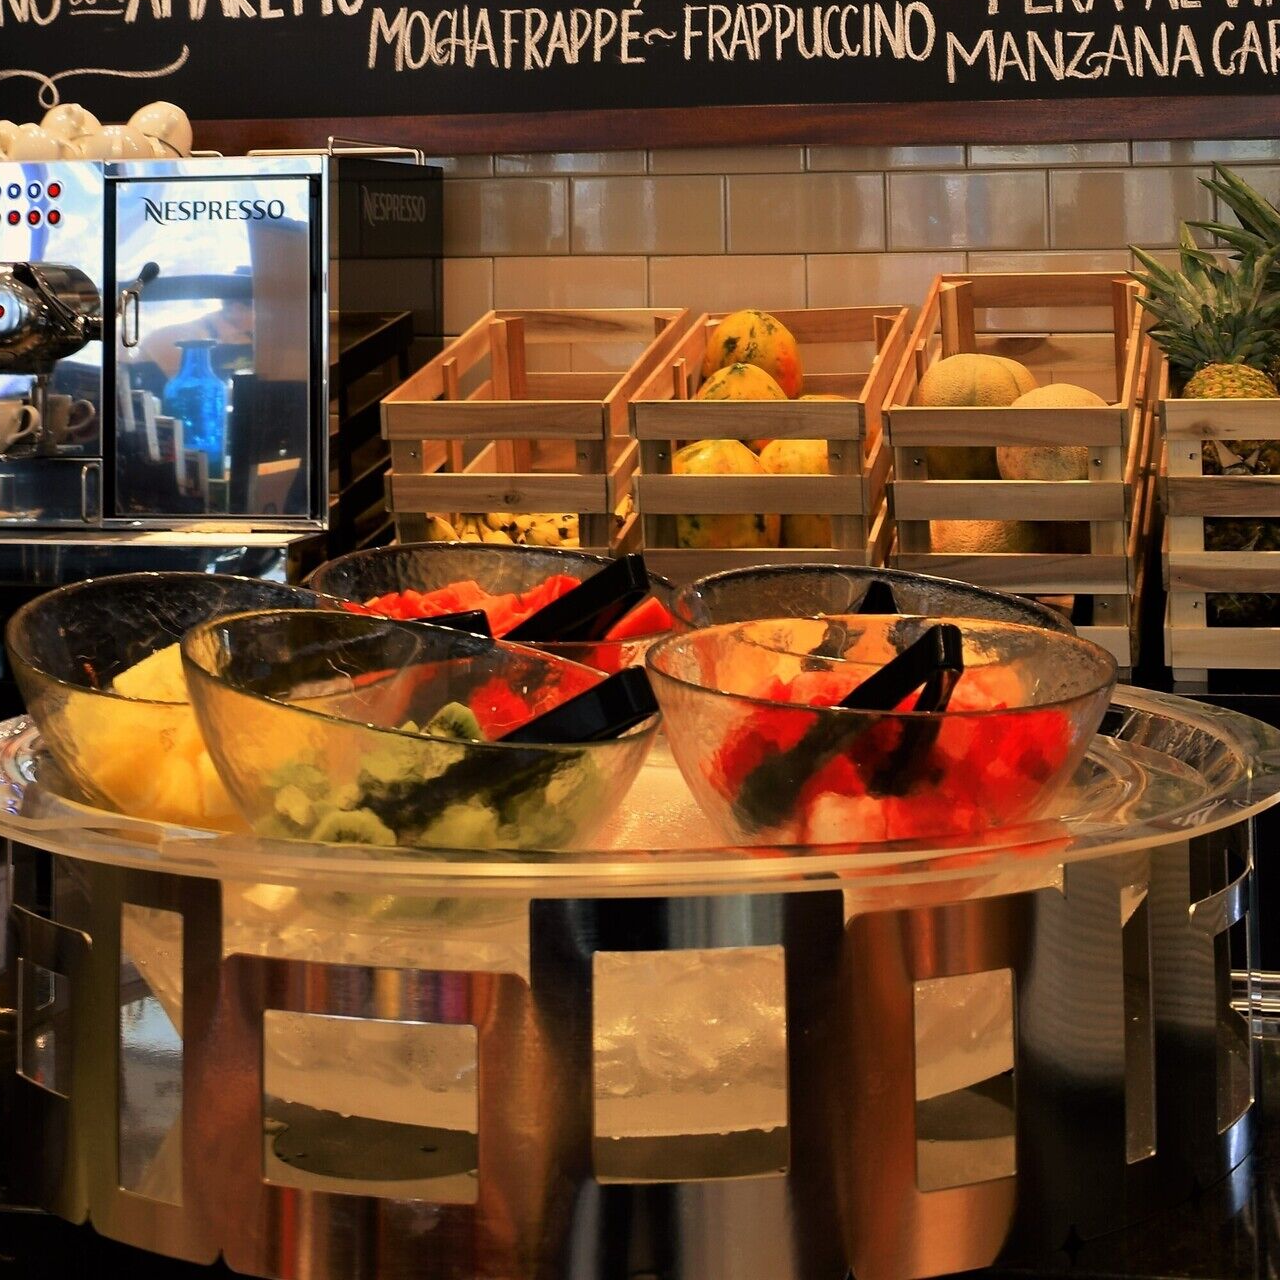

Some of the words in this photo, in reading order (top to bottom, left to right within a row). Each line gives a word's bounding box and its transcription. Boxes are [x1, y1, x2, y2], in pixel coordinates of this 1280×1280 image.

[369, 8, 499, 70] MOCHA
[684, 1, 938, 62] FRAPPUCCINO
[946, 25, 1203, 84] MANZANA
[142, 197, 285, 225] NESPRESSO
[361, 184, 427, 227] NESPRESSO
